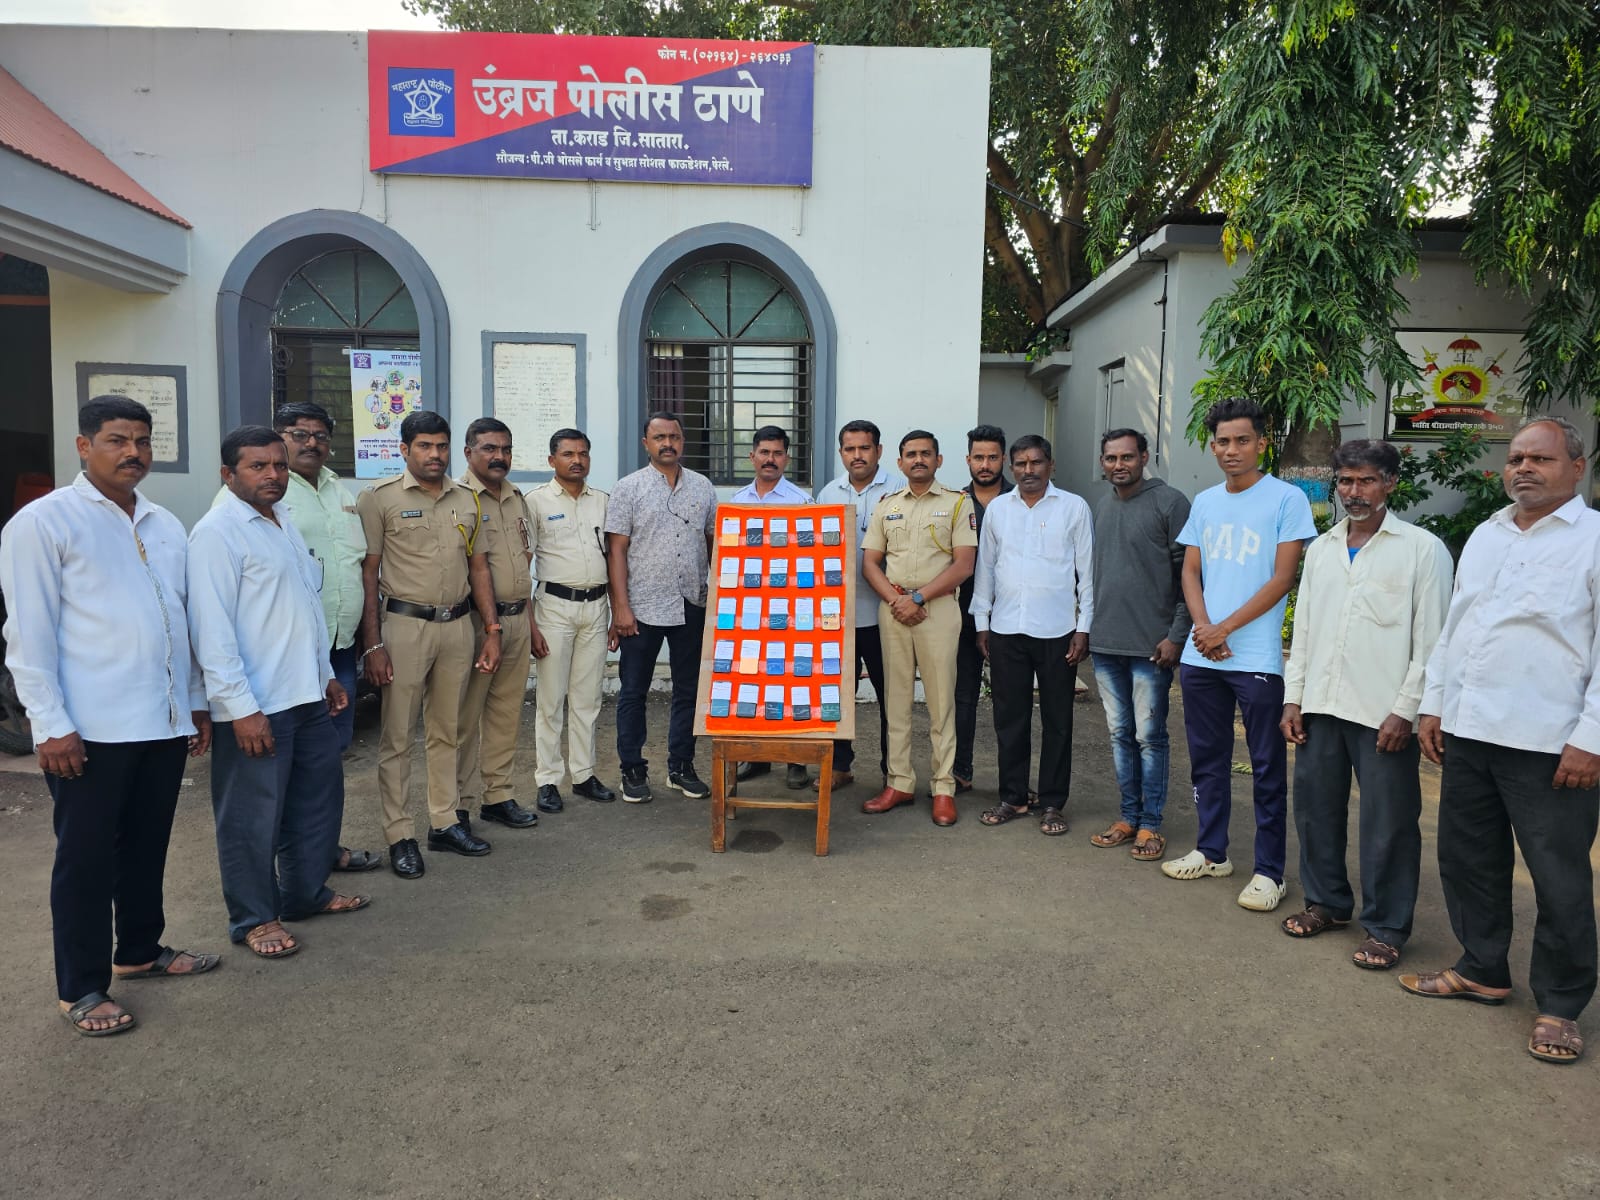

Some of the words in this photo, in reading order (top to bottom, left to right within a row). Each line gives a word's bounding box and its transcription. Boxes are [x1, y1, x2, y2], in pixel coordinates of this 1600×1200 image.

[657, 45, 677, 60] फोन
[472, 64, 557, 119] उंब्रज
[567, 65, 683, 123] पोलीस
[692, 70, 764, 124] ठाणे
[639, 154, 666, 169] सोशल
